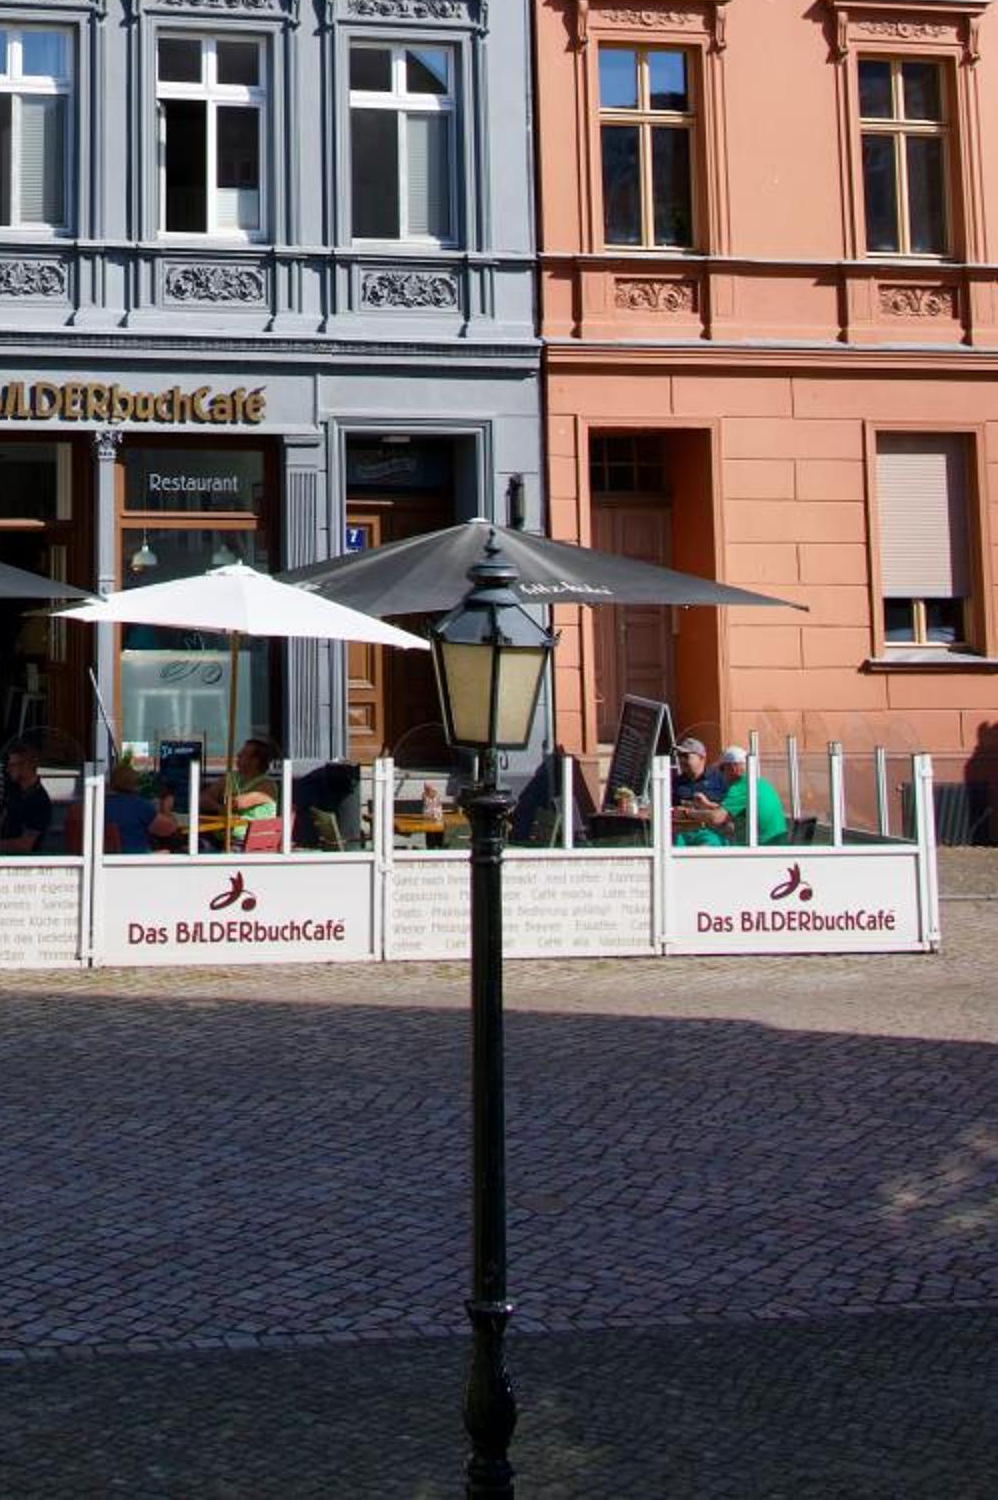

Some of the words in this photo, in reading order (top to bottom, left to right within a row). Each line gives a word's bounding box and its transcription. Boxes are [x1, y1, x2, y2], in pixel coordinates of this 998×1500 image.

[148, 473, 238, 492] Restaurant
[349, 528, 358, 544] 7
[128, 923, 169, 945] Das
[175, 918, 346, 943] BILDERbuchCafé
[698, 911, 734, 933] Das
[740, 910, 896, 932] BILDERbuchCafé
